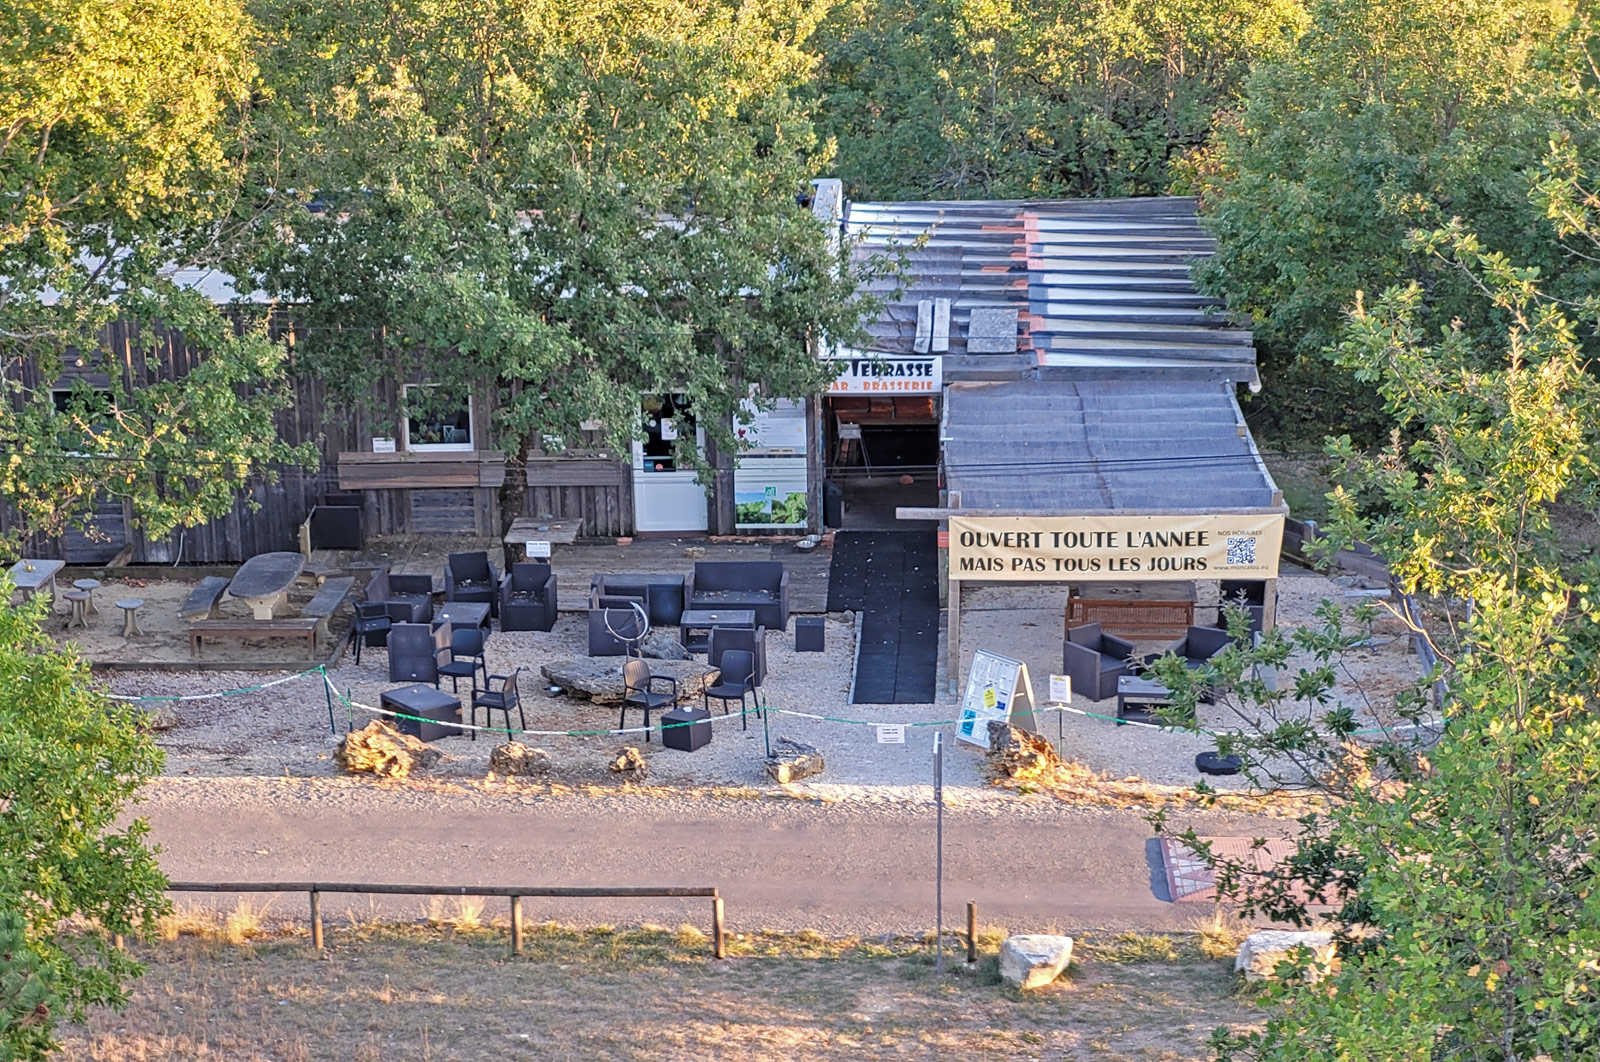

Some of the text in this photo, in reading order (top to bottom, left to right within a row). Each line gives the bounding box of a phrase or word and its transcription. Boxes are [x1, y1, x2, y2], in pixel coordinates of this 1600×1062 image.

[824, 381, 849, 391] AR
[863, 381, 933, 391] BRASSERIE
[960, 531, 1044, 548] OUVERT
[1050, 531, 1119, 548] TOUTE
[1127, 531, 1209, 548] L'ANNEE
[960, 557, 1207, 572] MAIS PAS TOUS LES JOURS
